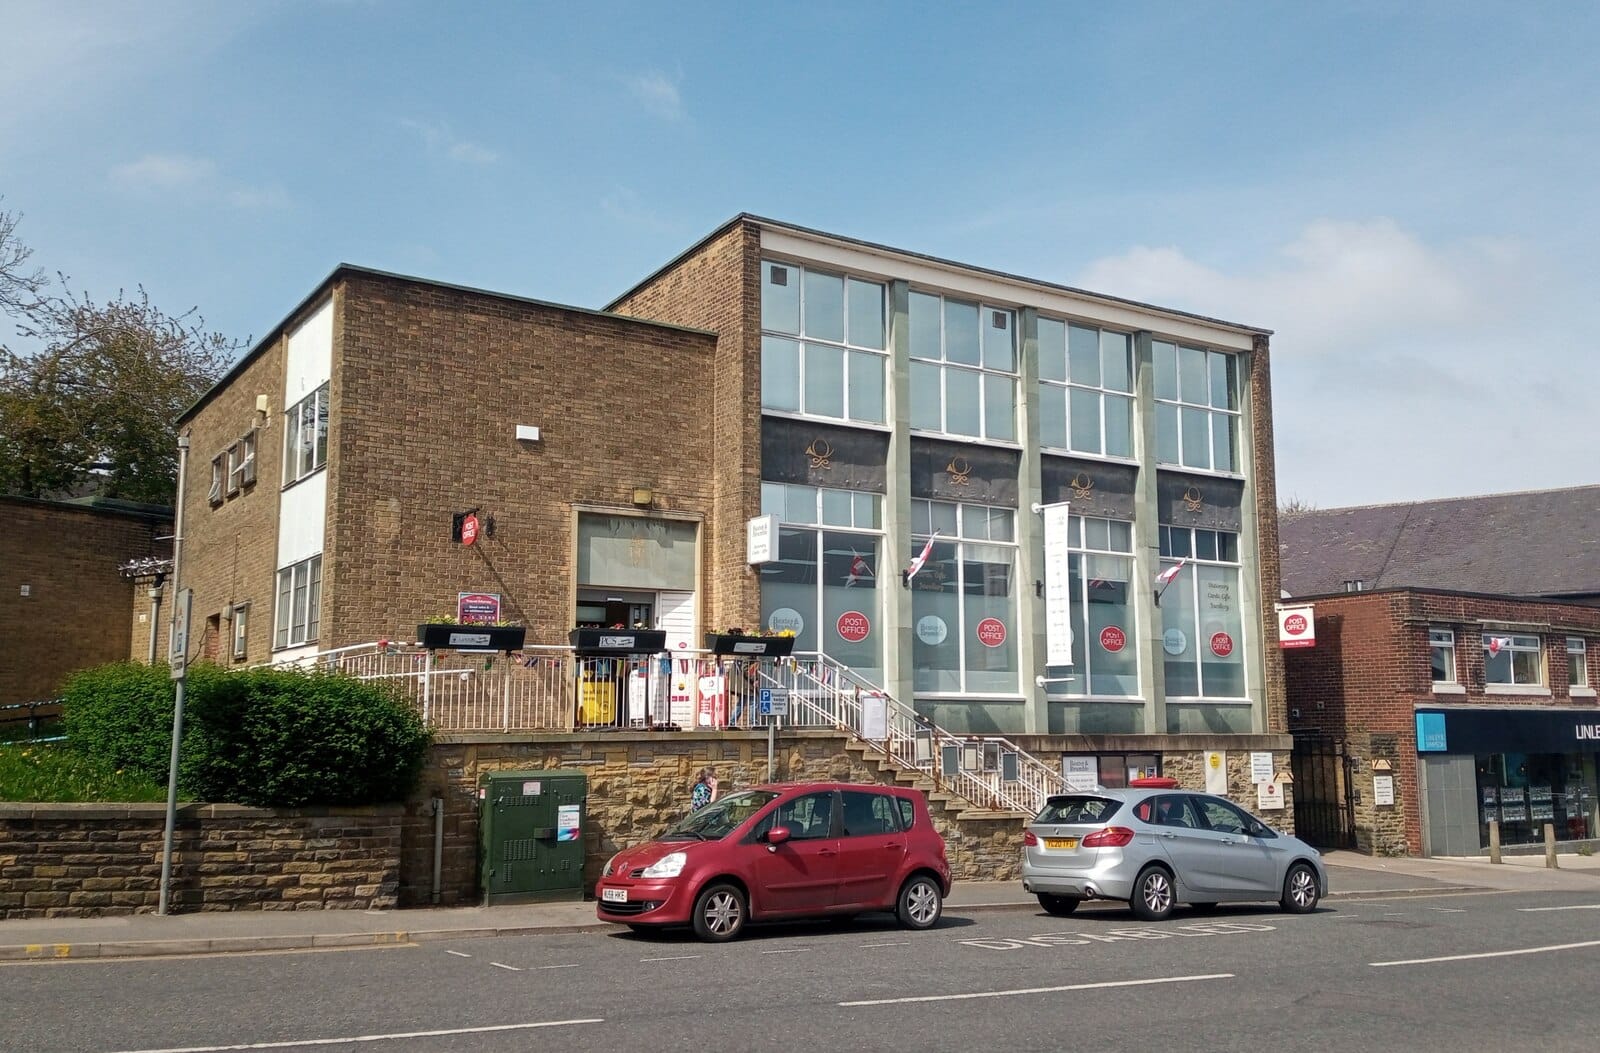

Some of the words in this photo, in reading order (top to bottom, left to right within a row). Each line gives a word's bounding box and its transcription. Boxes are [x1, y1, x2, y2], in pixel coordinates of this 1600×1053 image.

[845, 618, 862, 626] POST
[841, 626, 865, 634] OFFICE
[980, 632, 1003, 640] OFFICE
[1105, 631, 1120, 639] POST
[1103, 638, 1123, 646] OFFICE
[1213, 643, 1230, 651] OFFICE
[763, 691, 769, 700] P
[951, 921, 1277, 951] DISABLED
